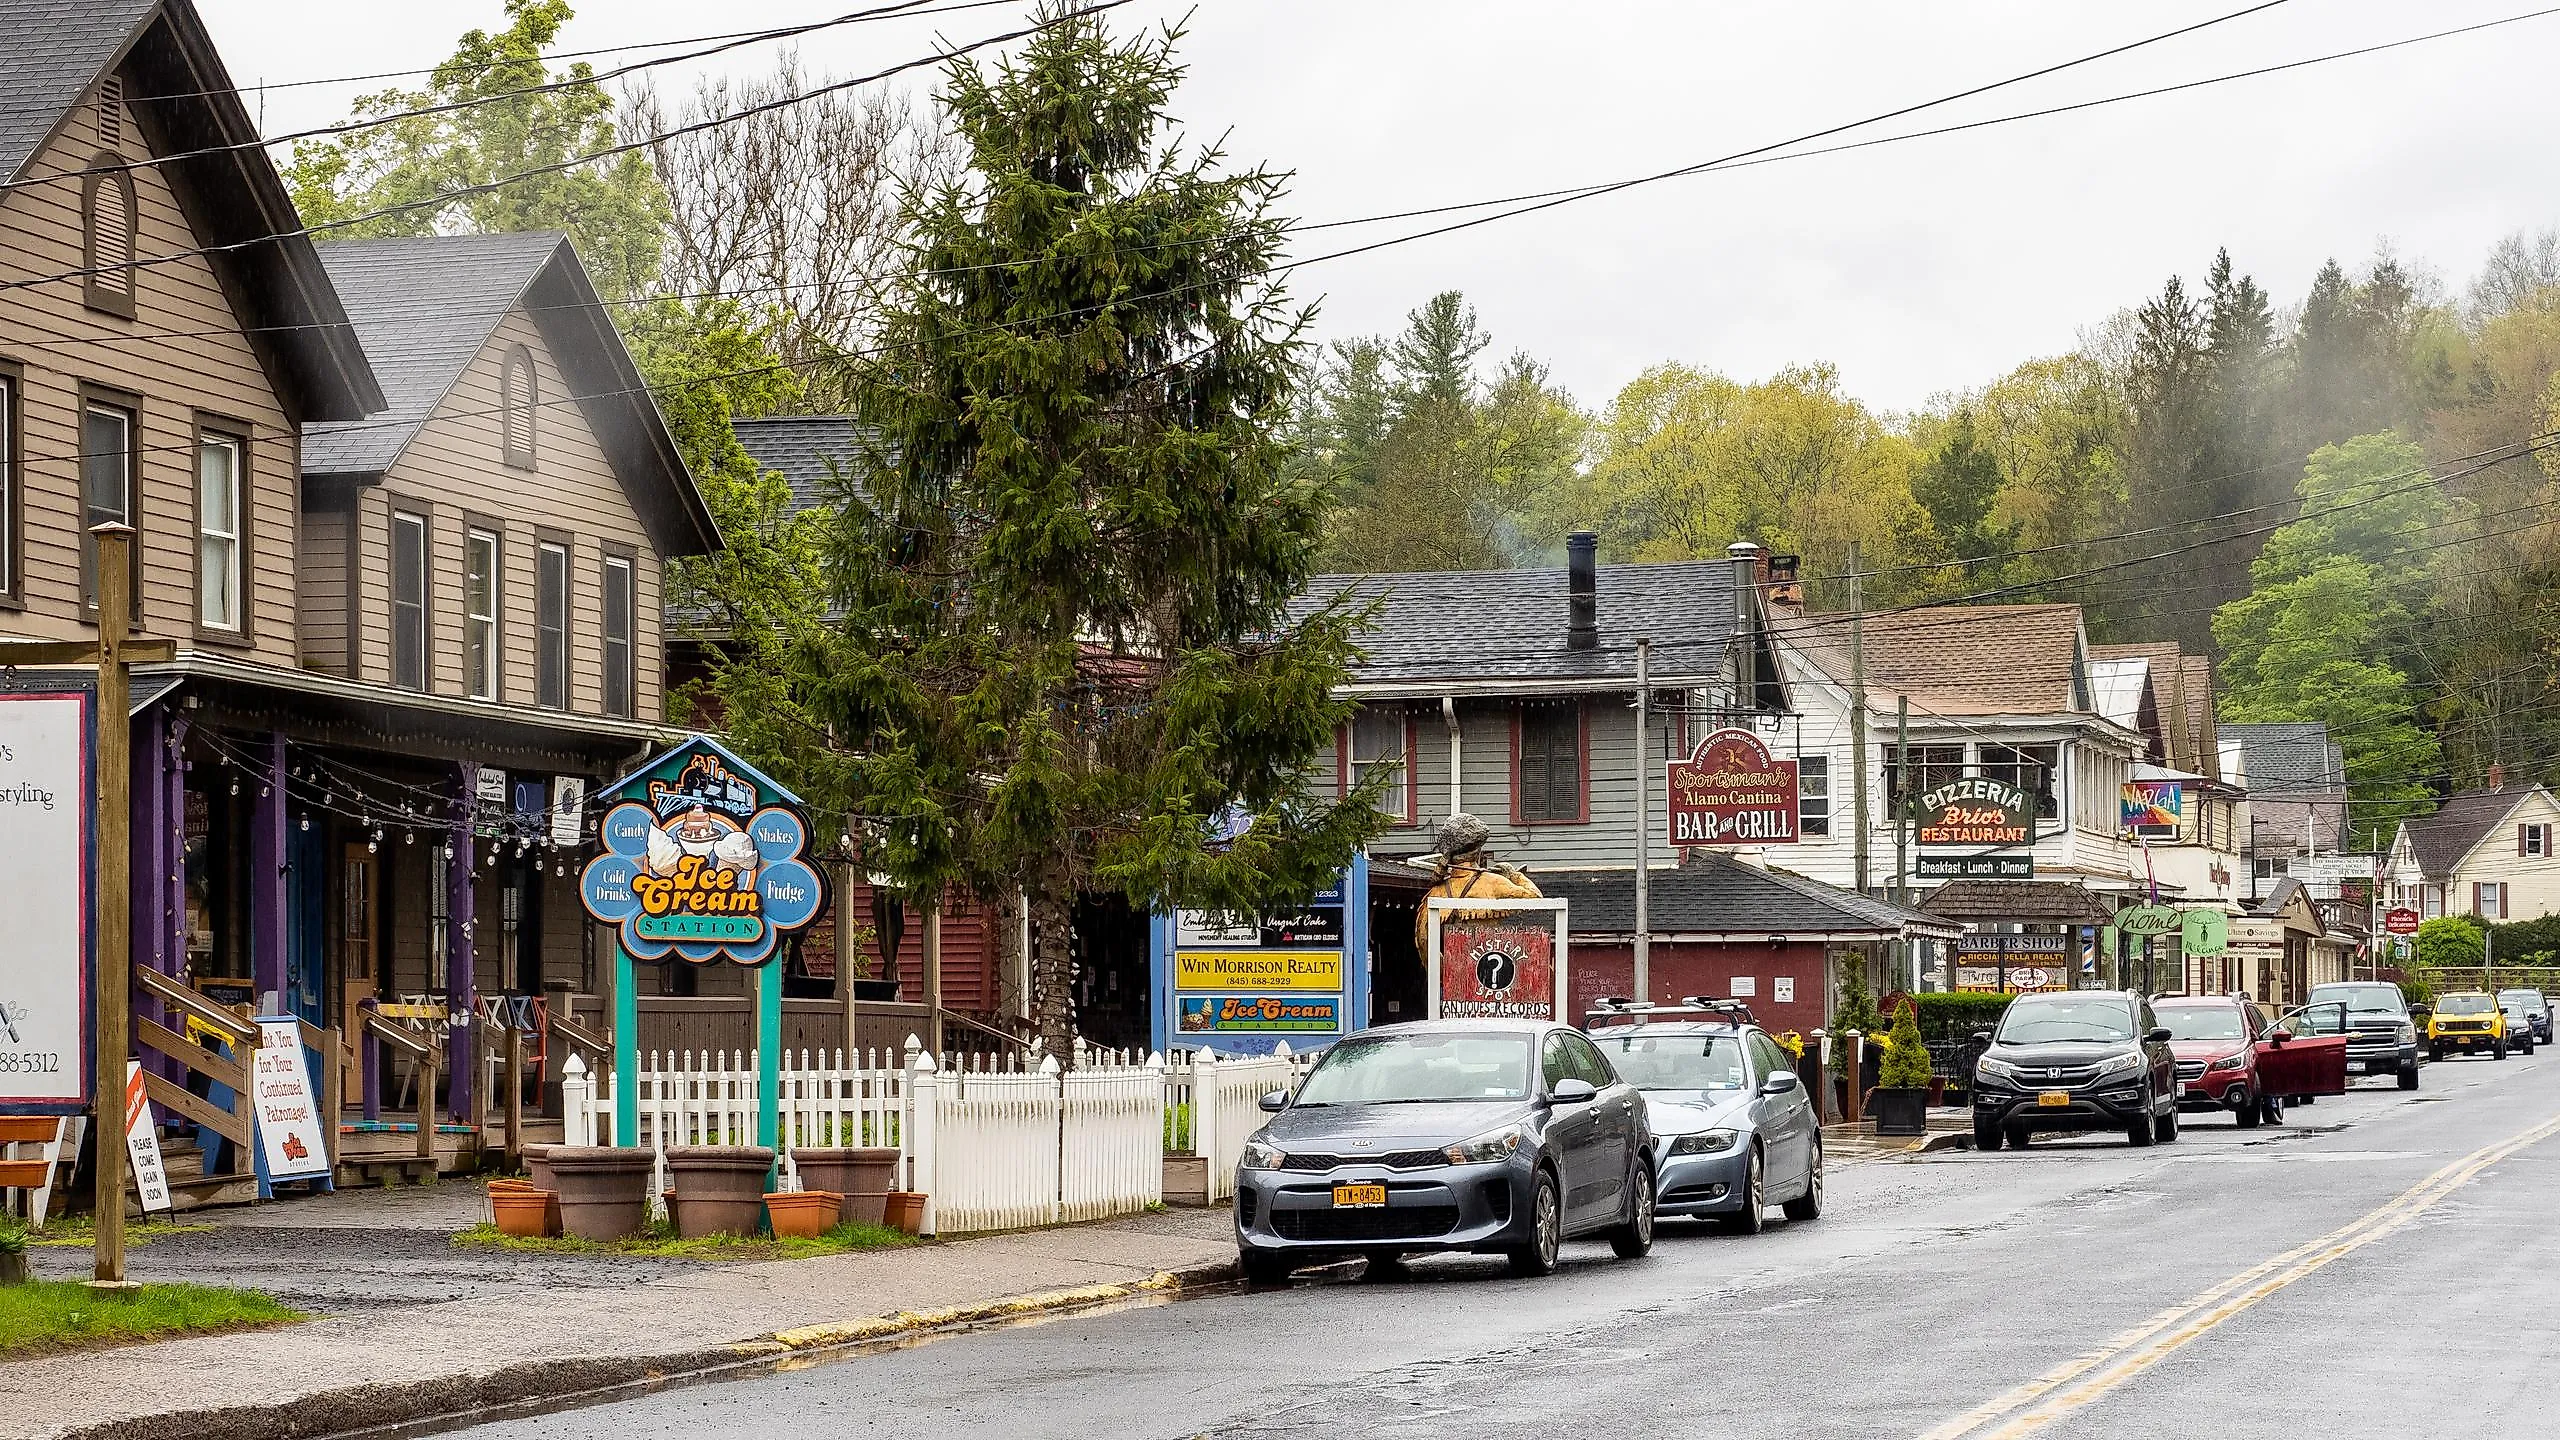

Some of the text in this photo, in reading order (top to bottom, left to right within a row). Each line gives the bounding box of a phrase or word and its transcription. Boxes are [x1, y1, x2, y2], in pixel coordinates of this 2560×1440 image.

[1695, 733, 1769, 770] AUTHENTIC MEXICAN FOOD
[1674, 766, 1791, 793] Sportsman's
[1685, 789, 1782, 806] Alamo Cantina
[1922, 780, 2024, 813] PIZZERIA
[2123, 784, 2176, 813] VARGA
[1937, 804, 2006, 825] Brio's
[614, 822, 647, 842] Candy
[1676, 811, 1719, 840] BAR
[1735, 809, 1794, 839] GRILL
[758, 827, 794, 845] Shakes
[1921, 828, 2028, 842] RESTAURANT
[673, 855, 735, 891] Ice
[1920, 861, 2029, 874] Breakfast Lunch Dinner
[603, 870, 625, 884] Cold
[596, 888, 632, 902] Drinks
[632, 875, 759, 914] Cream
[767, 881, 806, 904] Fudge
[2122, 905, 2178, 930] home
[644, 920, 754, 935] STATION
[1469, 939, 1529, 961] MYSTERY
[2022, 937, 2063, 949] SHOP
[2032, 953, 2065, 961] REALTY
[1226, 977, 1291, 985] (845) 688-2929
[1476, 987, 1511, 1000] SPOT
[1220, 999, 1332, 1020] Ice Cream
[1443, 1001, 1549, 1015] ANTIQUES RECORDS
[1220, 1021, 1332, 1029] STATION
[275, 1030, 293, 1048] You
[258, 1055, 293, 1073] for Your
[259, 1078, 303, 1099] Continued
[264, 1103, 309, 1124] Patronage!
[133, 1138, 152, 1150] PLEASE
[138, 1155, 155, 1167] COME
[142, 1172, 158, 1184] AGAIN
[146, 1188, 162, 1200] SOON
